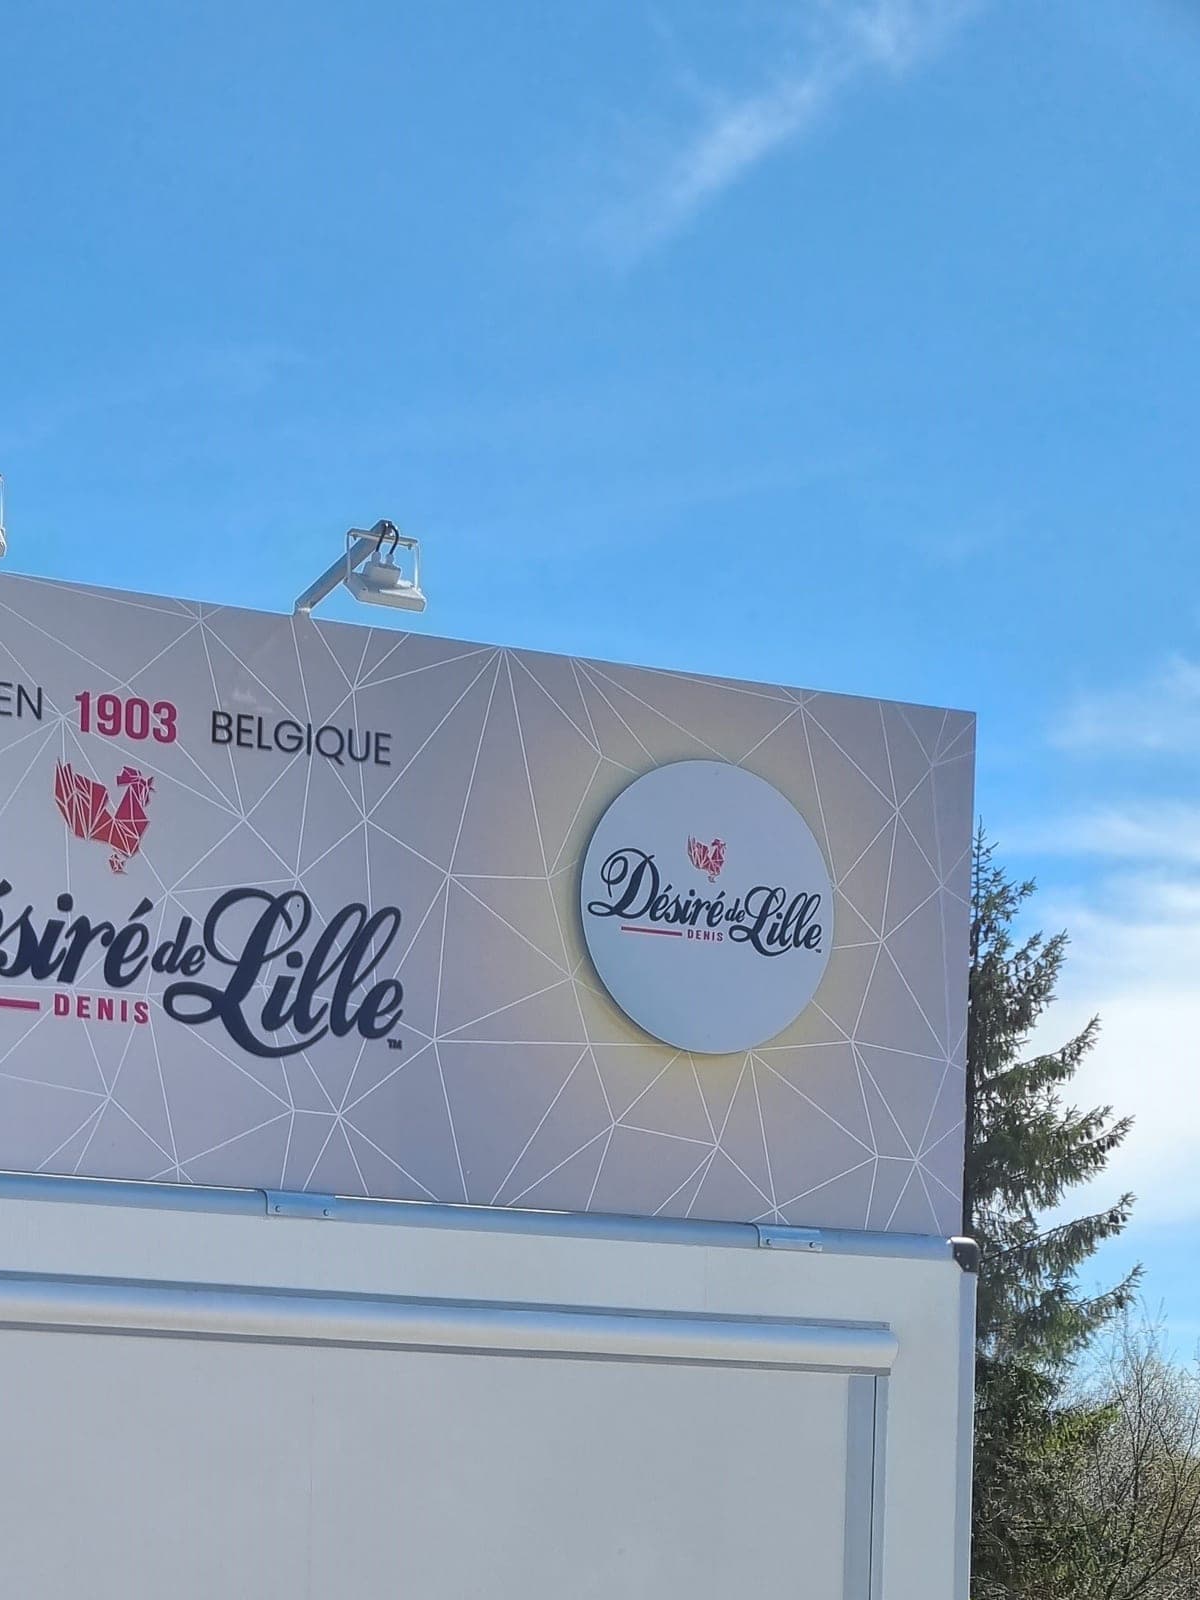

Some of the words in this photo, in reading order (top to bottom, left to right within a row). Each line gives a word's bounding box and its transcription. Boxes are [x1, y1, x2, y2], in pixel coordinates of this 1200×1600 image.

[74, 690, 178, 744] 1903
[211, 710, 392, 766] BELGIQUE
[588, 848, 725, 927] Désiré
[724, 897, 746, 923] de
[151, 915, 206, 977] de
[687, 929, 724, 942] DENIS
[728, 886, 822, 957] Lille
[162, 887, 404, 1059] Lille
[53, 993, 149, 1025] DENIS
